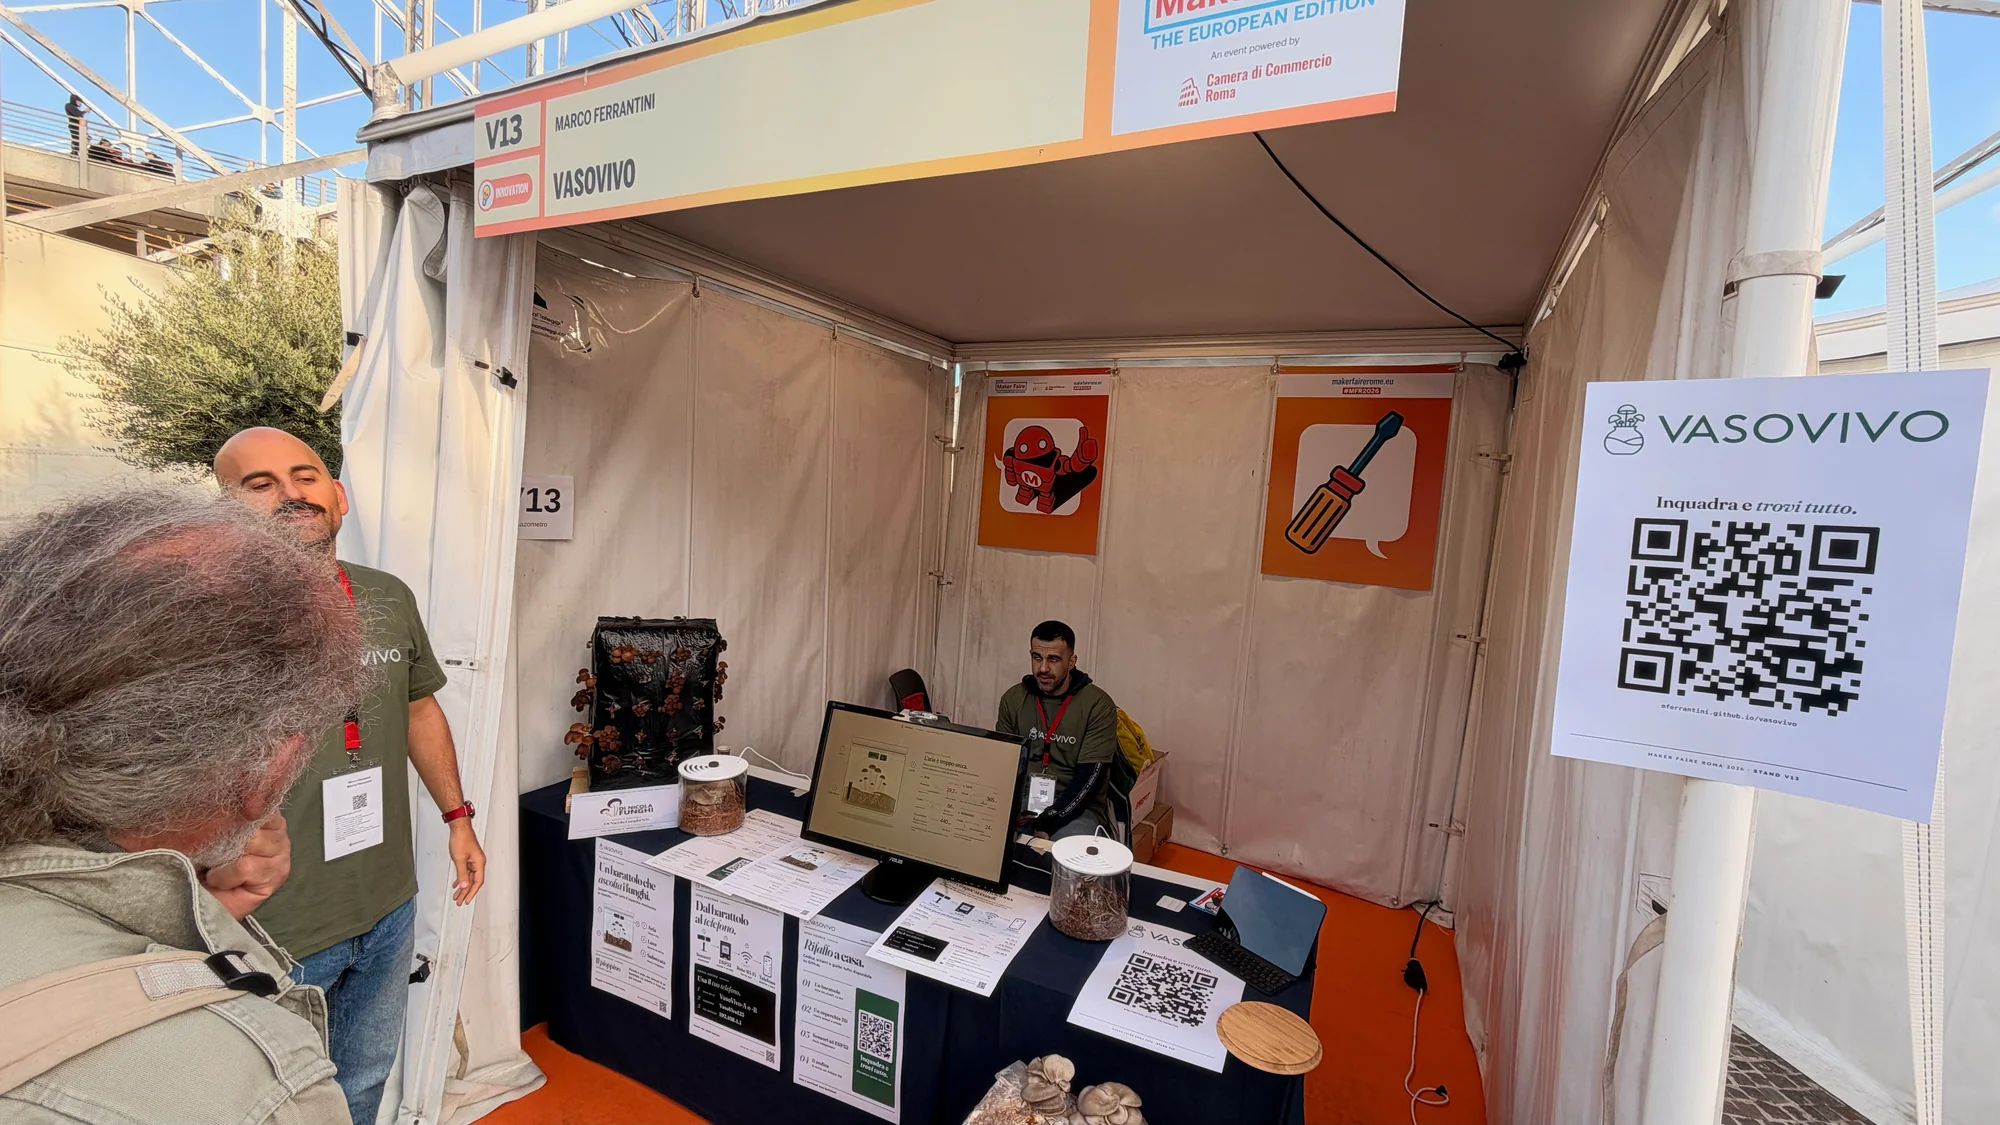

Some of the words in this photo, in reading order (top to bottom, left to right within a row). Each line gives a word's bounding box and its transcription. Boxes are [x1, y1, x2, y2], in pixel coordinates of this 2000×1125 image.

[1151, 30, 1184, 50] THE
[1189, 8, 1288, 43] EUROPEAN
[1210, 50, 1222, 60] An
[1224, 46, 1247, 57] event
[1249, 39, 1287, 54] powered
[1289, 36, 1300, 48] by
[1206, 67, 1248, 87] Camera
[1252, 64, 1262, 79] di
[1266, 54, 1333, 77] Commercio
[1205, 88, 1236, 102] Roma
[555, 109, 592, 132] MARCO
[593, 93, 656, 124] FERRANTINI
[485, 113, 523, 150] V13
[495, 182, 529, 199] INNOVATION
[553, 158, 636, 200] VASOVIVO
[1332, 378, 1394, 386] makerfairerome.eu
[1658, 410, 1949, 444] VASOVIVO
[520, 487, 561, 513] 13
[1656, 496, 1738, 514] Inquadra
[1743, 502, 1752, 512] e
[1756, 499, 1802, 513] trovi
[1804, 501, 1858, 516] tutto.
[360, 648, 401, 666] VIVO
[1648, 752, 1673, 760] MAKER
[1702, 761, 1723, 769] ROMA
[1753, 769, 1781, 778] STAND
[1784, 774, 1800, 782] V13
[619, 807, 653, 815] FUNGHI
[599, 861, 610, 874] Un
[610, 865, 643, 885] barattolo
[643, 878, 656, 891] che
[598, 877, 622, 890] ascolta
[626, 883, 650, 901] funghi.
[695, 913, 703, 925] al
[703, 917, 737, 936] telefono.
[696, 900, 711, 914] Dal
[711, 903, 749, 926] barattolo
[834, 951, 840, 960] a
[841, 954, 865, 968] casa.
[802, 979, 811, 988] 01
[801, 1004, 812, 1014] 02
[860, 1054, 884, 1070] Inquadra
